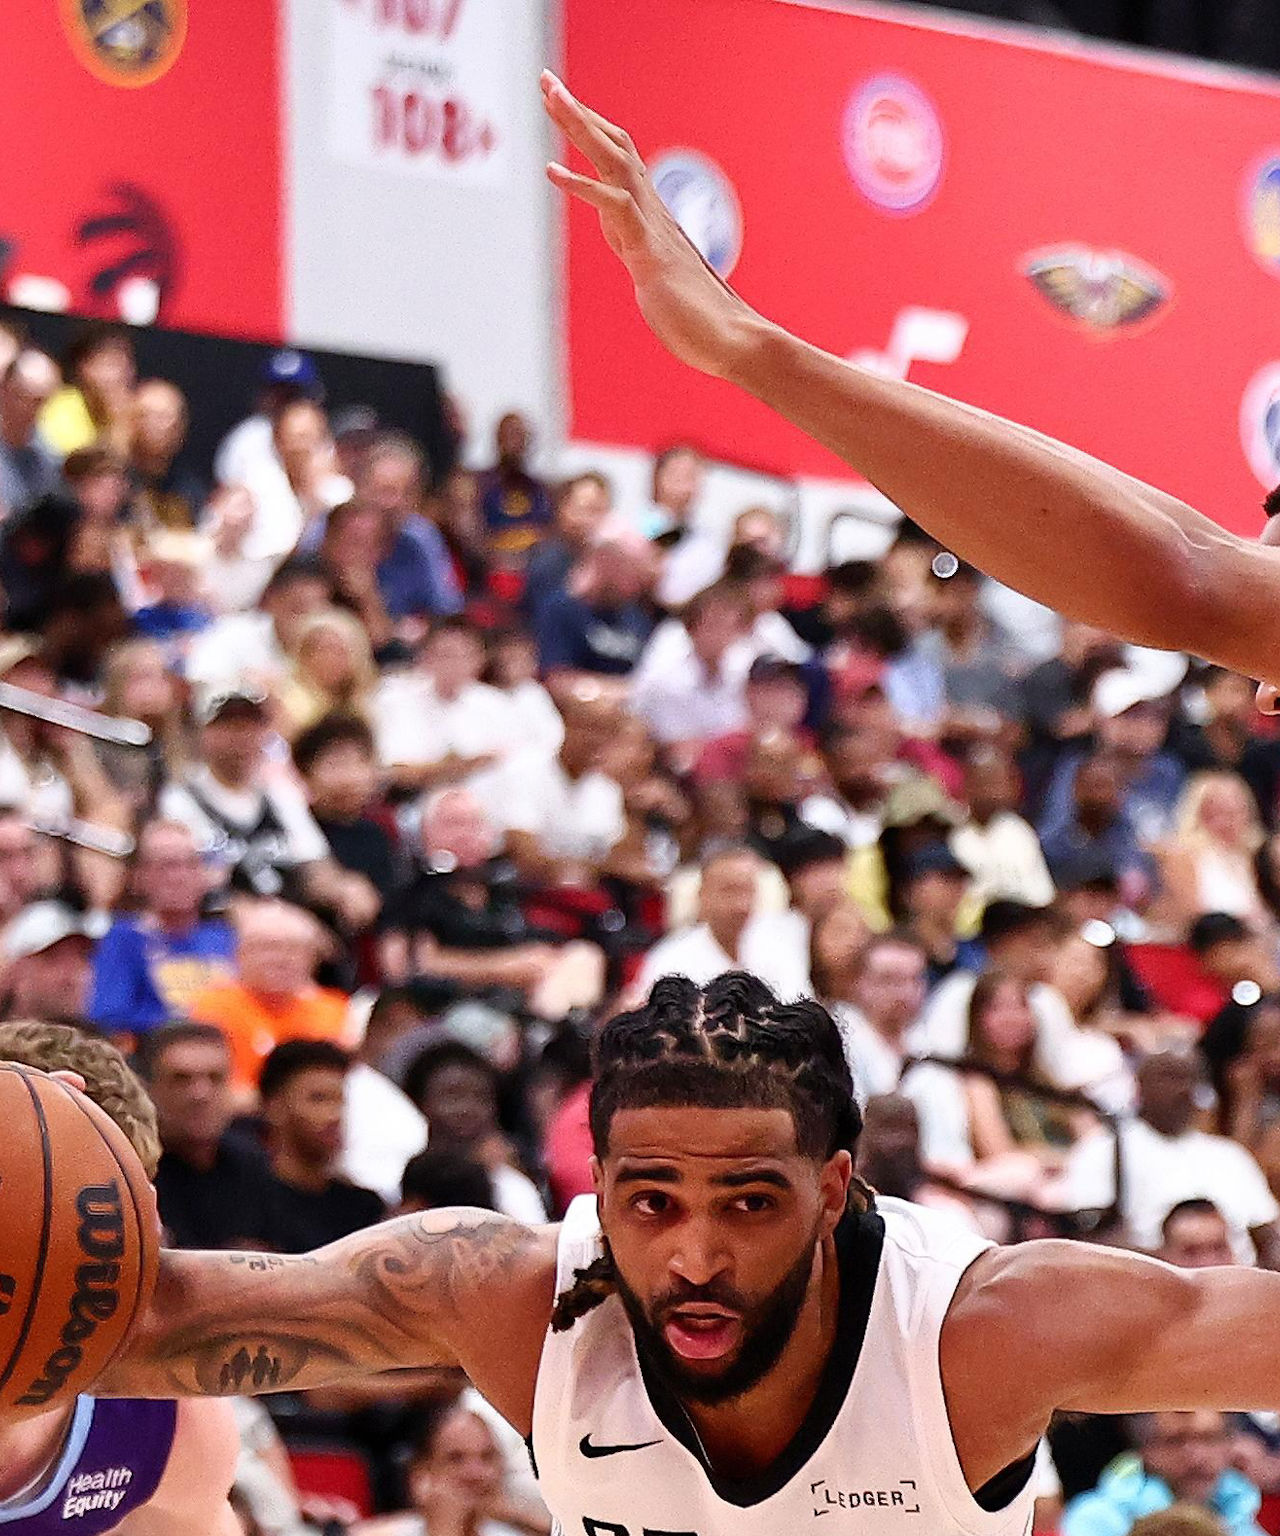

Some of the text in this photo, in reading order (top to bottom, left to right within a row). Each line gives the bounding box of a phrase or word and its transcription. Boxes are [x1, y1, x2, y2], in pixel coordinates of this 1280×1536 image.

[68, 1467, 133, 1498] Health
[62, 1490, 126, 1519] Equity
[825, 1489, 904, 1509] LEDGER
